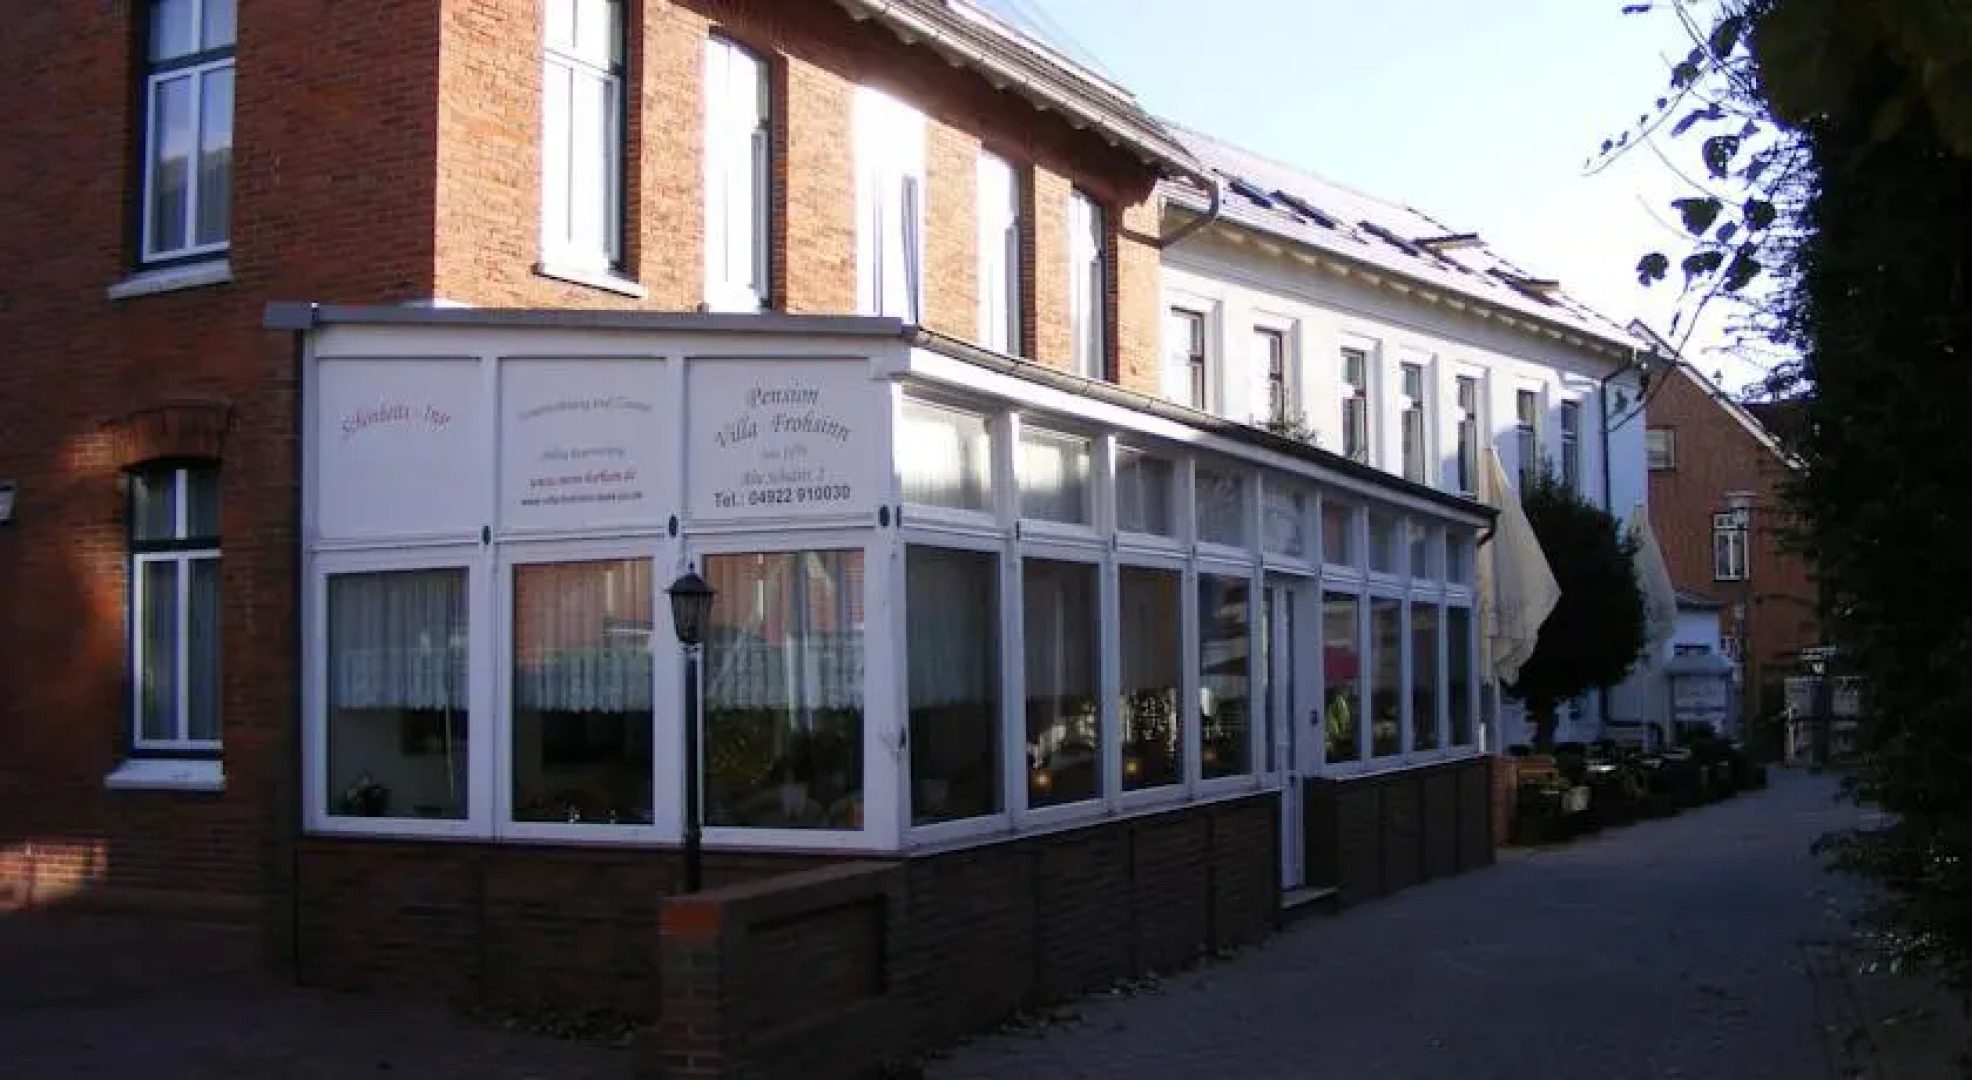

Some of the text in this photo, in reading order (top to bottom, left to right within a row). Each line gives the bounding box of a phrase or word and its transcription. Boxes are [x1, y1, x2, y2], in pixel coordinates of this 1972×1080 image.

[748, 381, 819, 407] Pension
[715, 411, 850, 447] Villa Frohsinn
[714, 484, 851, 508] Tel.: 04922 910030
